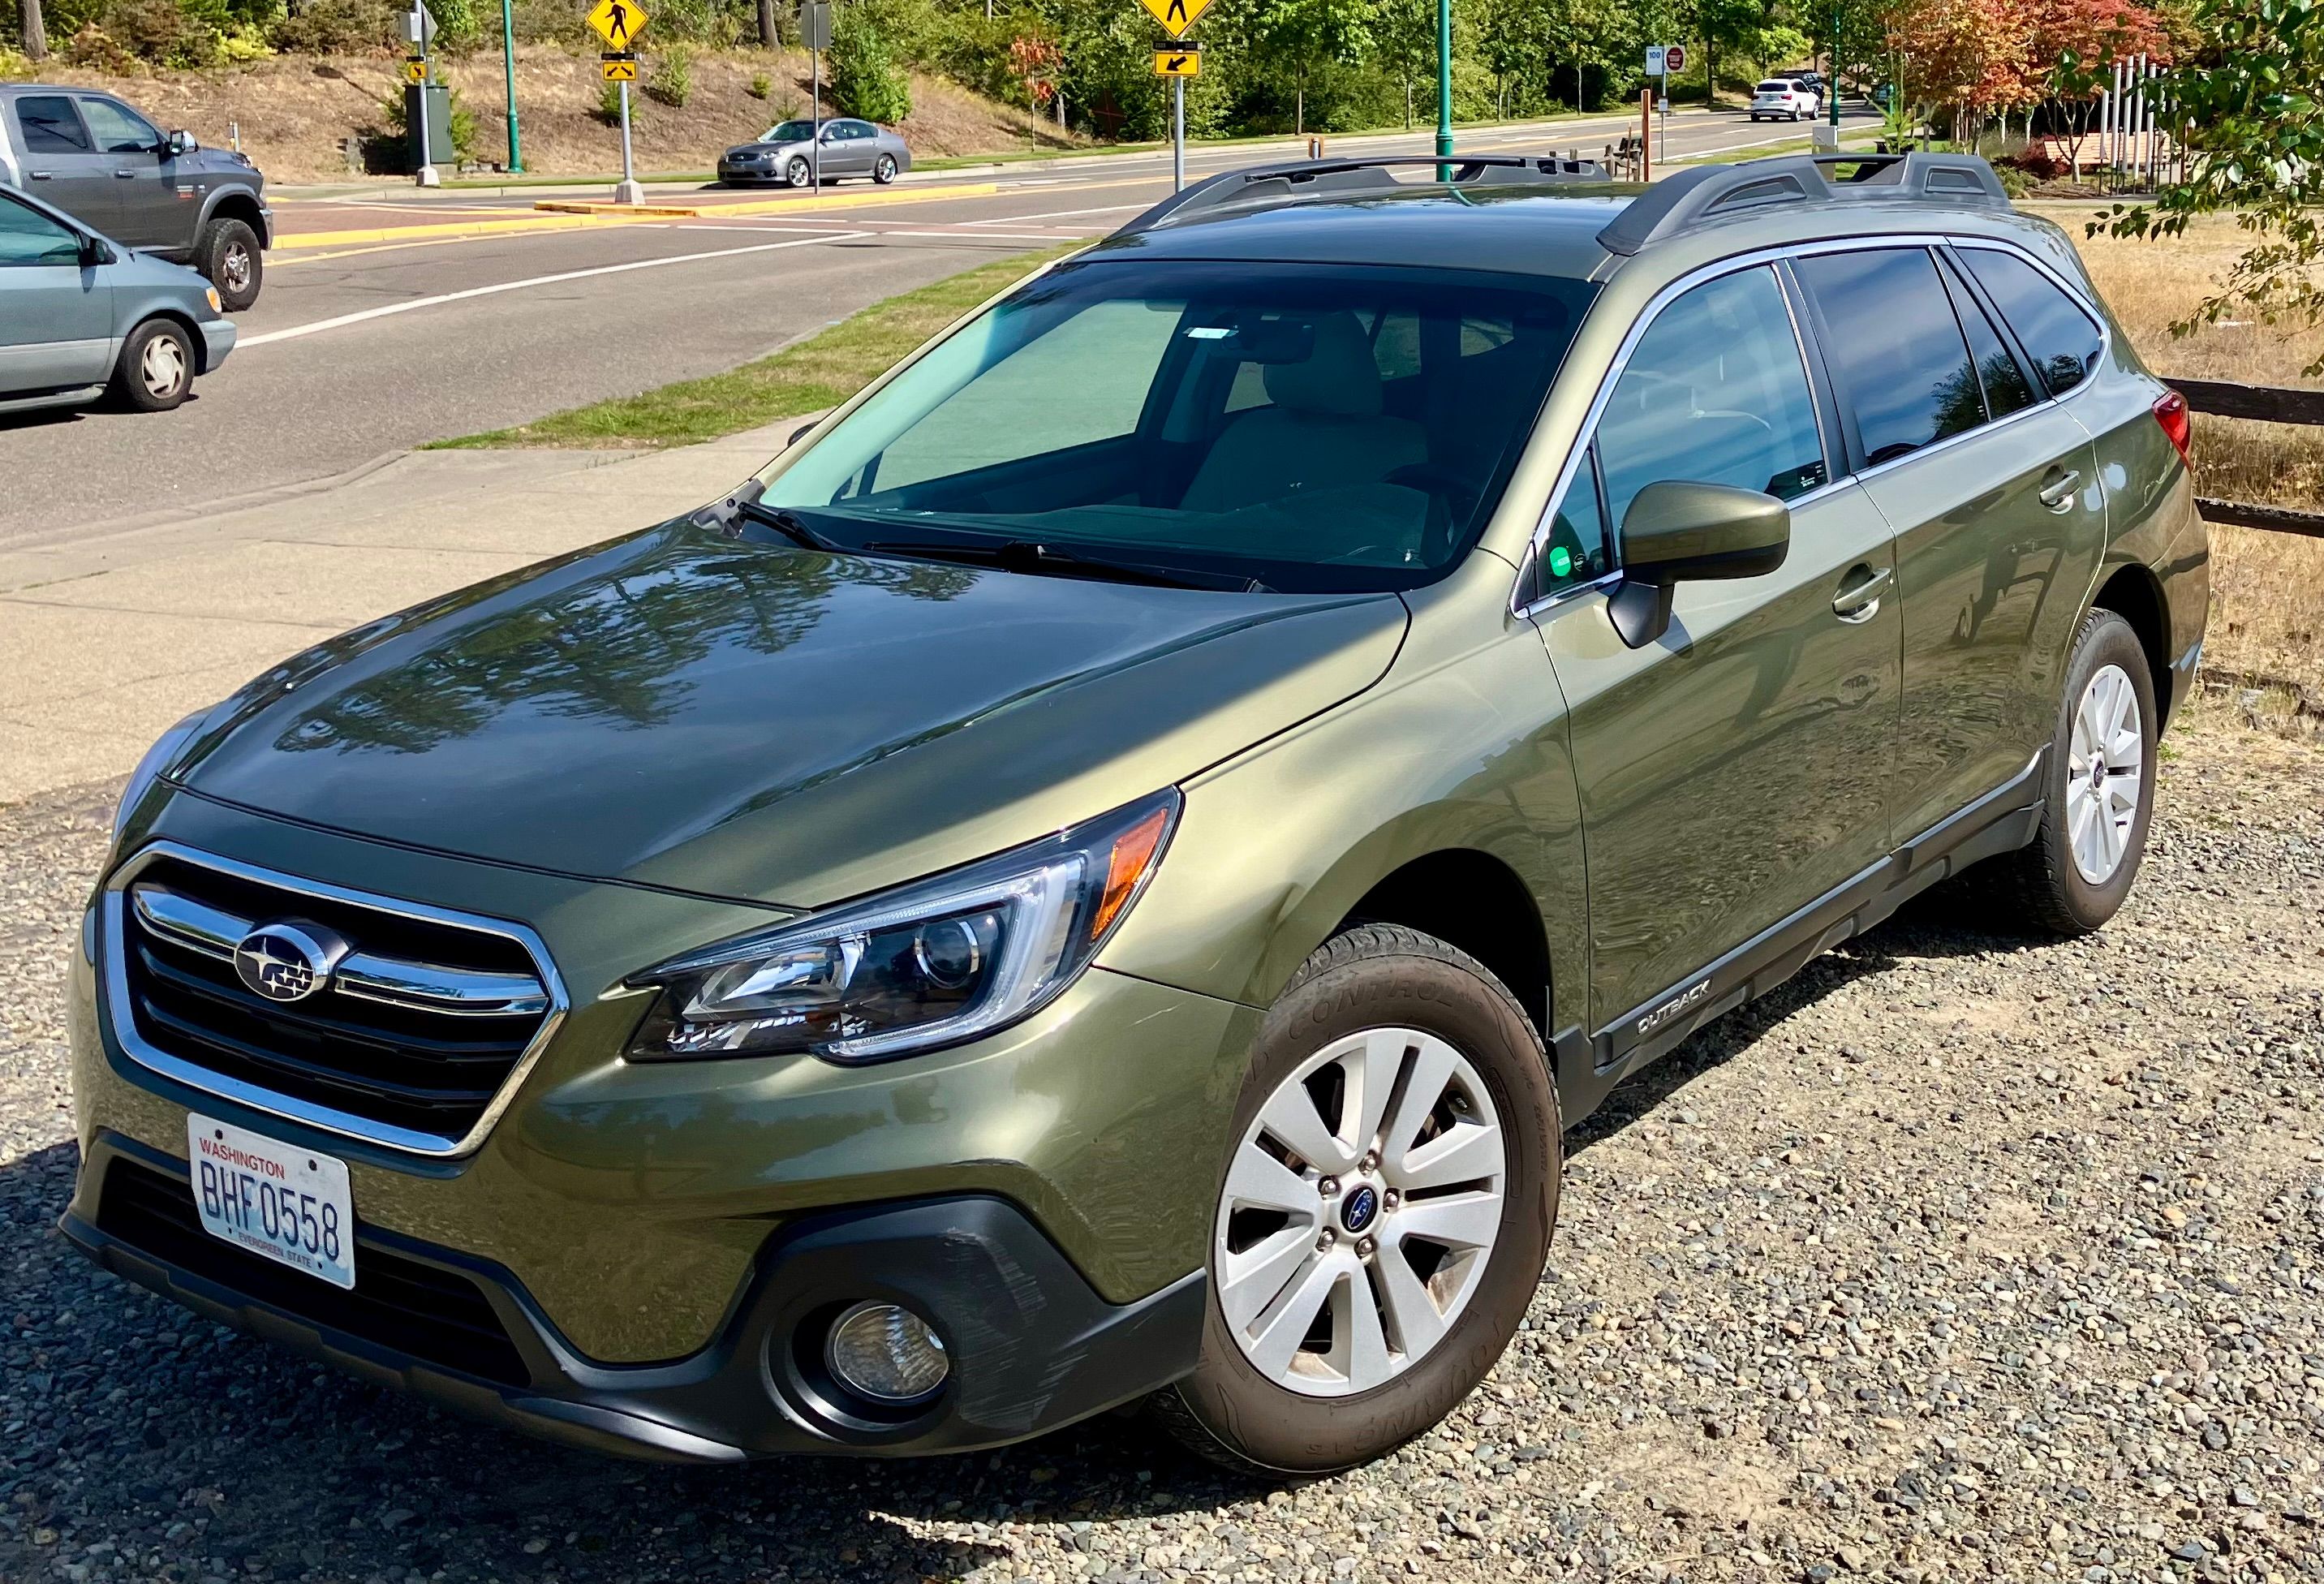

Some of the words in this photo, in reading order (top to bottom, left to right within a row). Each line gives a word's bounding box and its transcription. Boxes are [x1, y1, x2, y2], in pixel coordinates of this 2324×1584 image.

[1638, 979, 1711, 1034] OUTBACK
[199, 1137, 285, 1180] WASHINGTON
[200, 1160, 339, 1261] BHF0558
[239, 1232, 284, 1257] EVERGREEN
[287, 1250, 312, 1268] STATE
